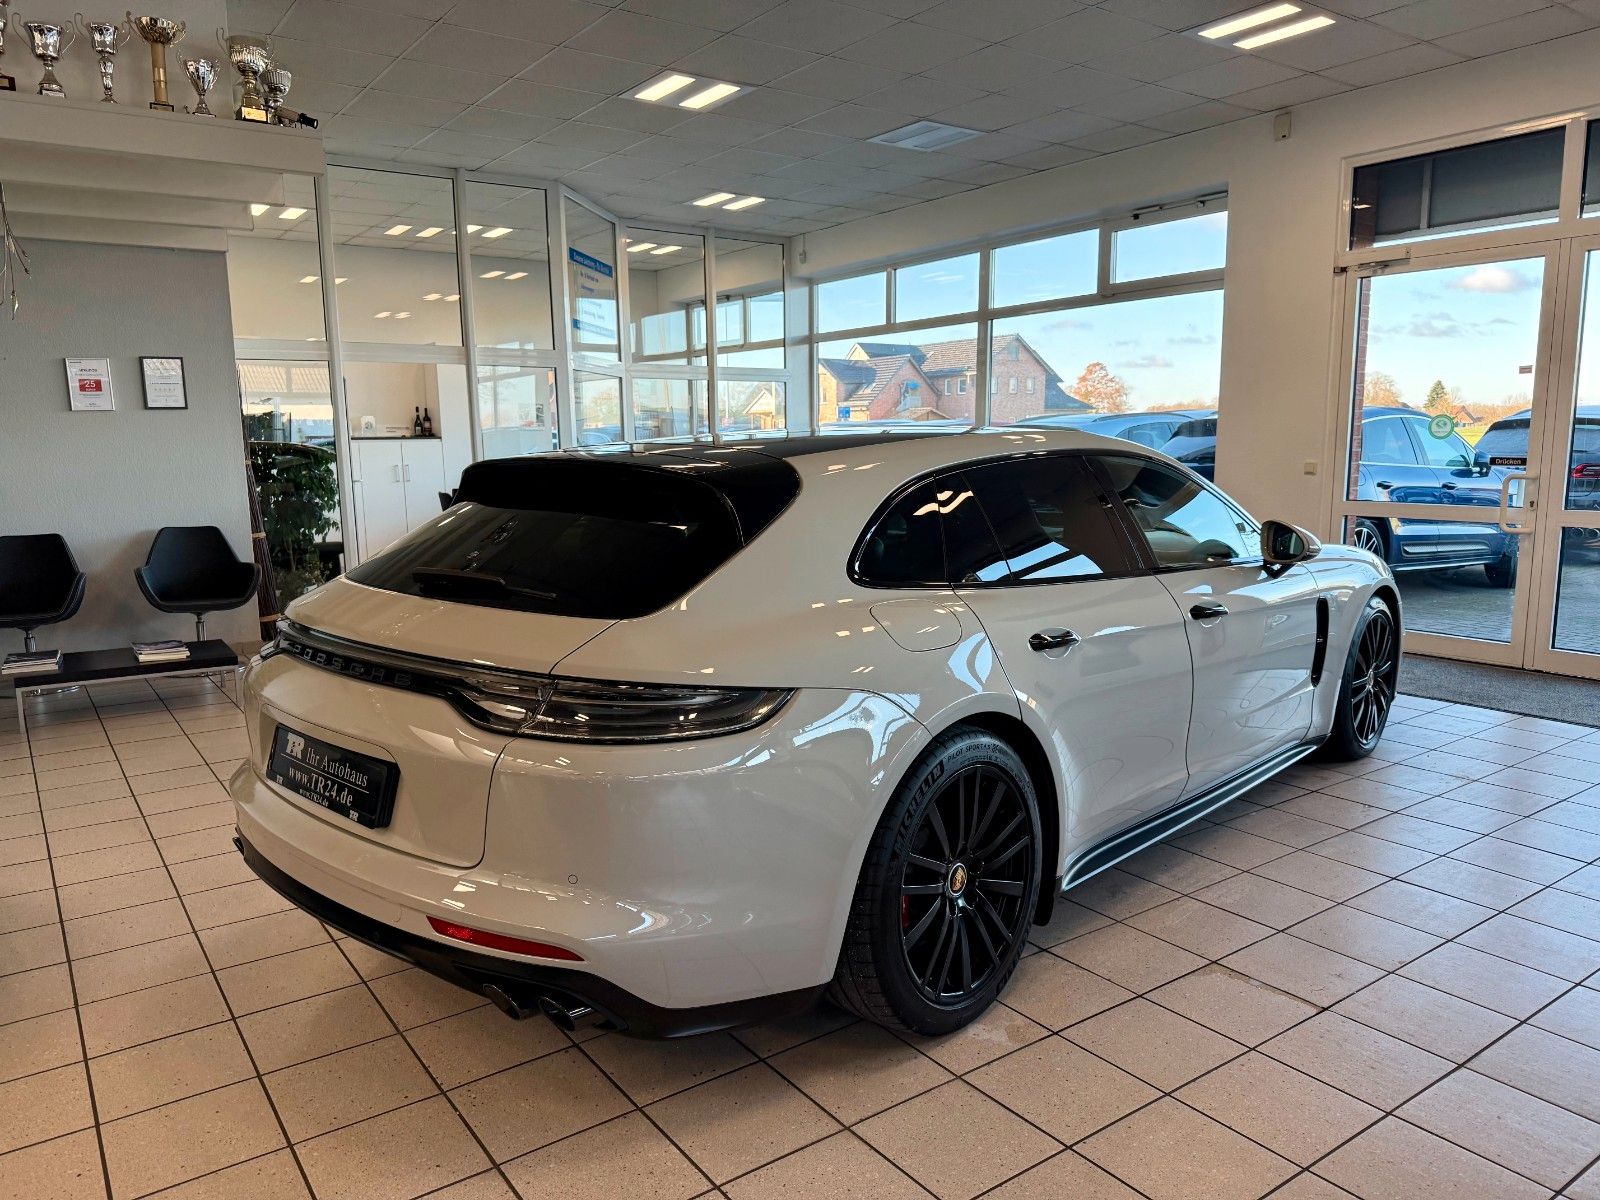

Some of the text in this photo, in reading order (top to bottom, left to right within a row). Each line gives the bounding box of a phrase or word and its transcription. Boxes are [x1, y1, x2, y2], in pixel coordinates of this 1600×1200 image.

[84, 380, 96, 388] 25
[292, 643, 412, 687] PORSCHE
[306, 747, 320, 767] Ihr
[321, 755, 368, 787] Autohaus
[947, 748, 963, 762] PILOT
[965, 743, 983, 753] SPORT
[288, 767, 353, 806] www.TR24.de
